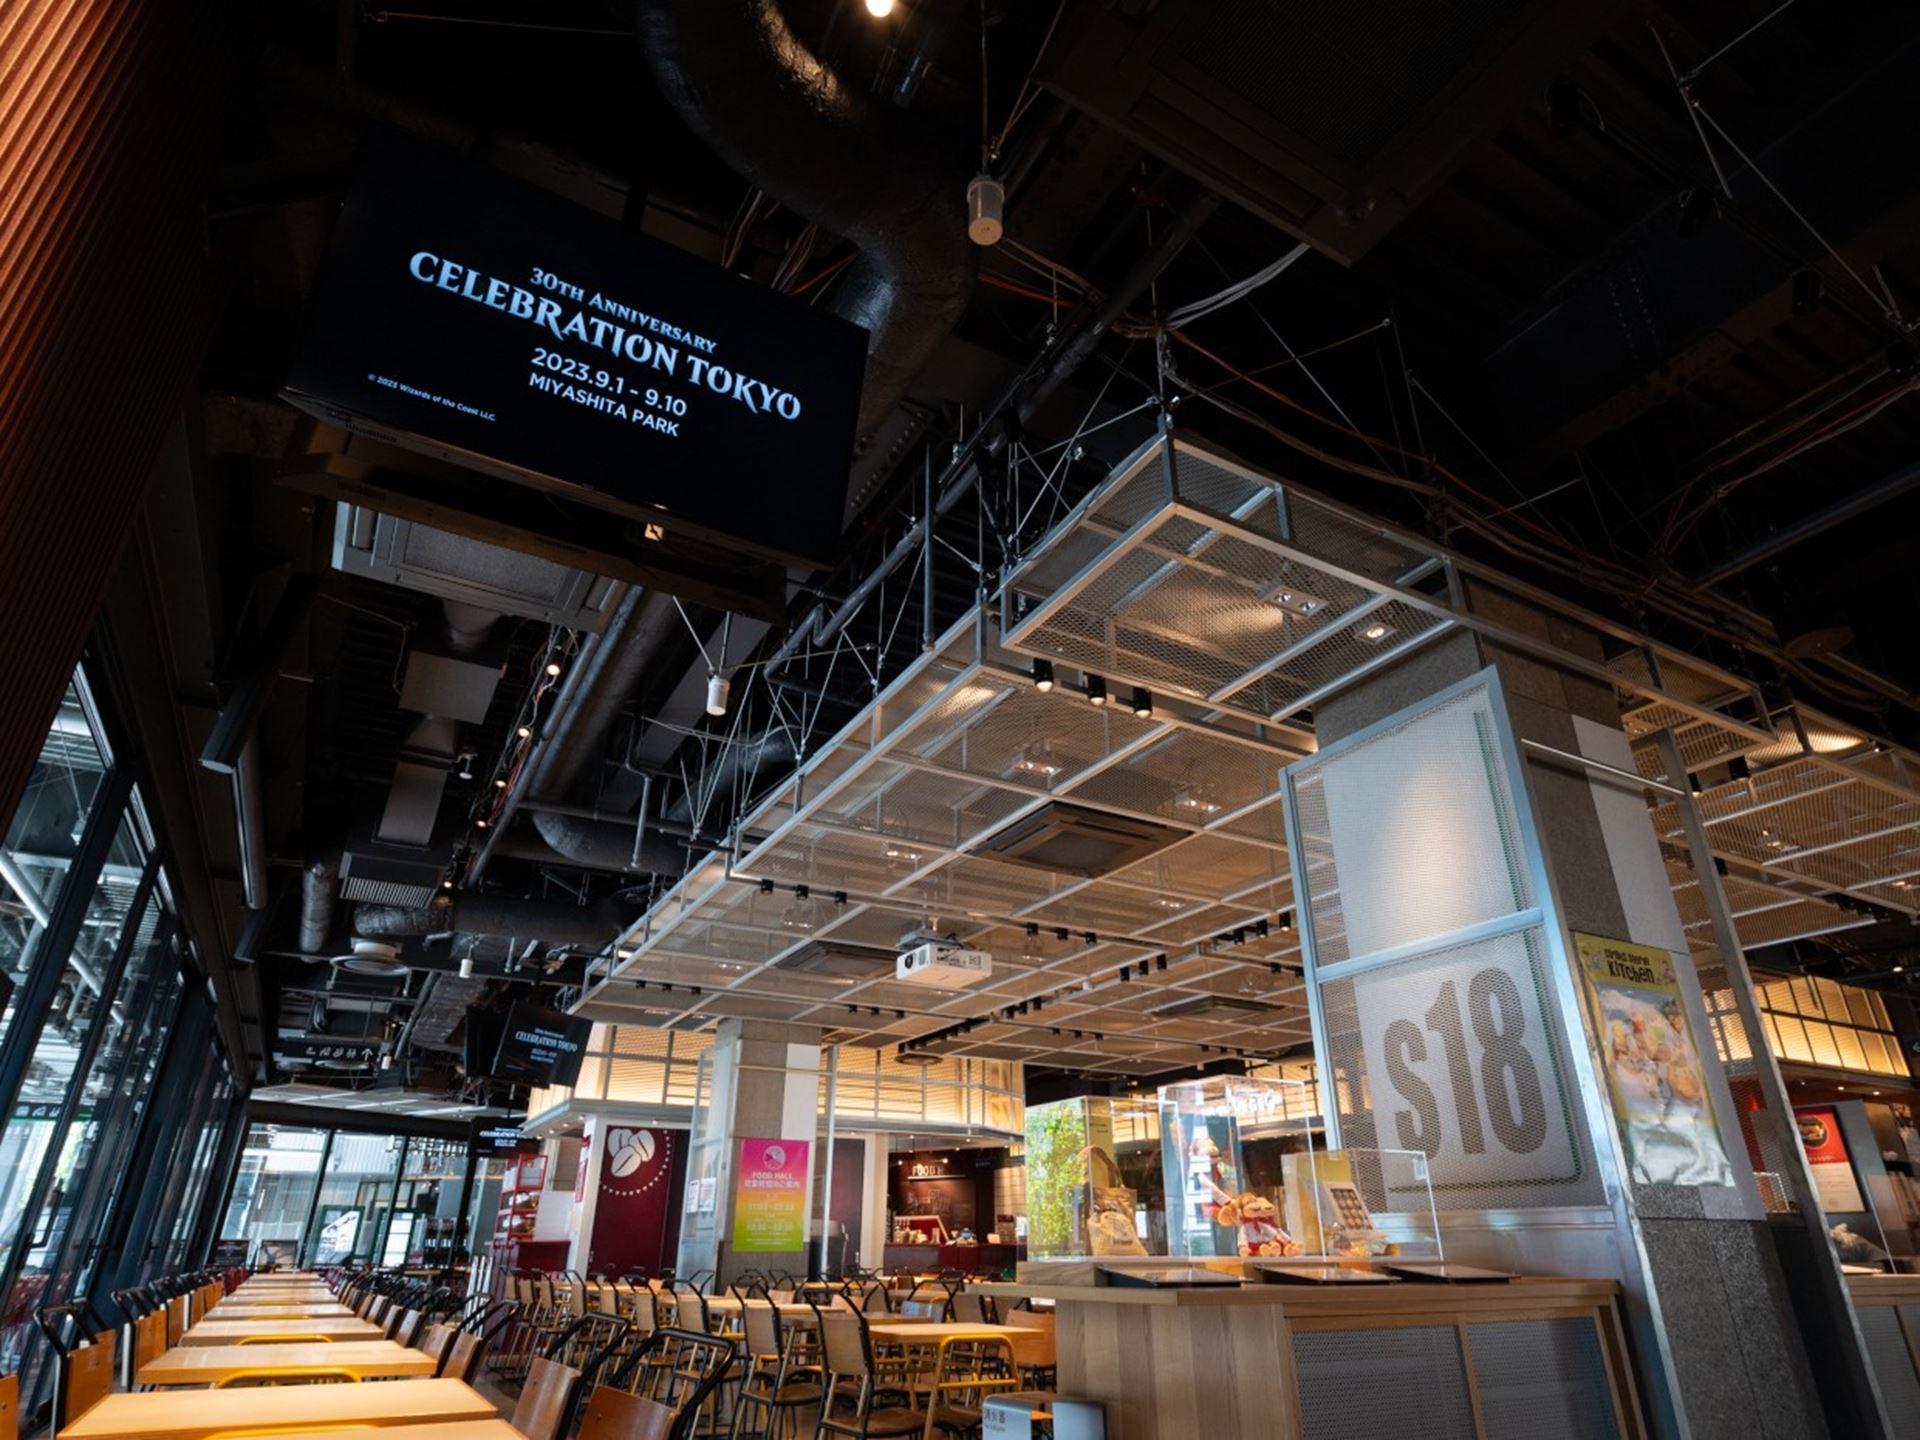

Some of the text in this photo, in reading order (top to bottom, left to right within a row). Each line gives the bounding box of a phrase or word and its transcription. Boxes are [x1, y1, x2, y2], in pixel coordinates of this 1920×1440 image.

[409, 251, 803, 421] CELEBRATION TOKYO
[529, 266, 718, 354] 30TH ANNIVERSARY
[399, 383, 431, 401] Wizards
[432, 395, 442, 403] of
[442, 398, 456, 408] the
[528, 371, 680, 437] MIYASHITA PARK
[530, 347, 625, 395] 2023.9.1
[644, 388, 688, 417] 9.10
[1383, 967, 1547, 1162] S18
